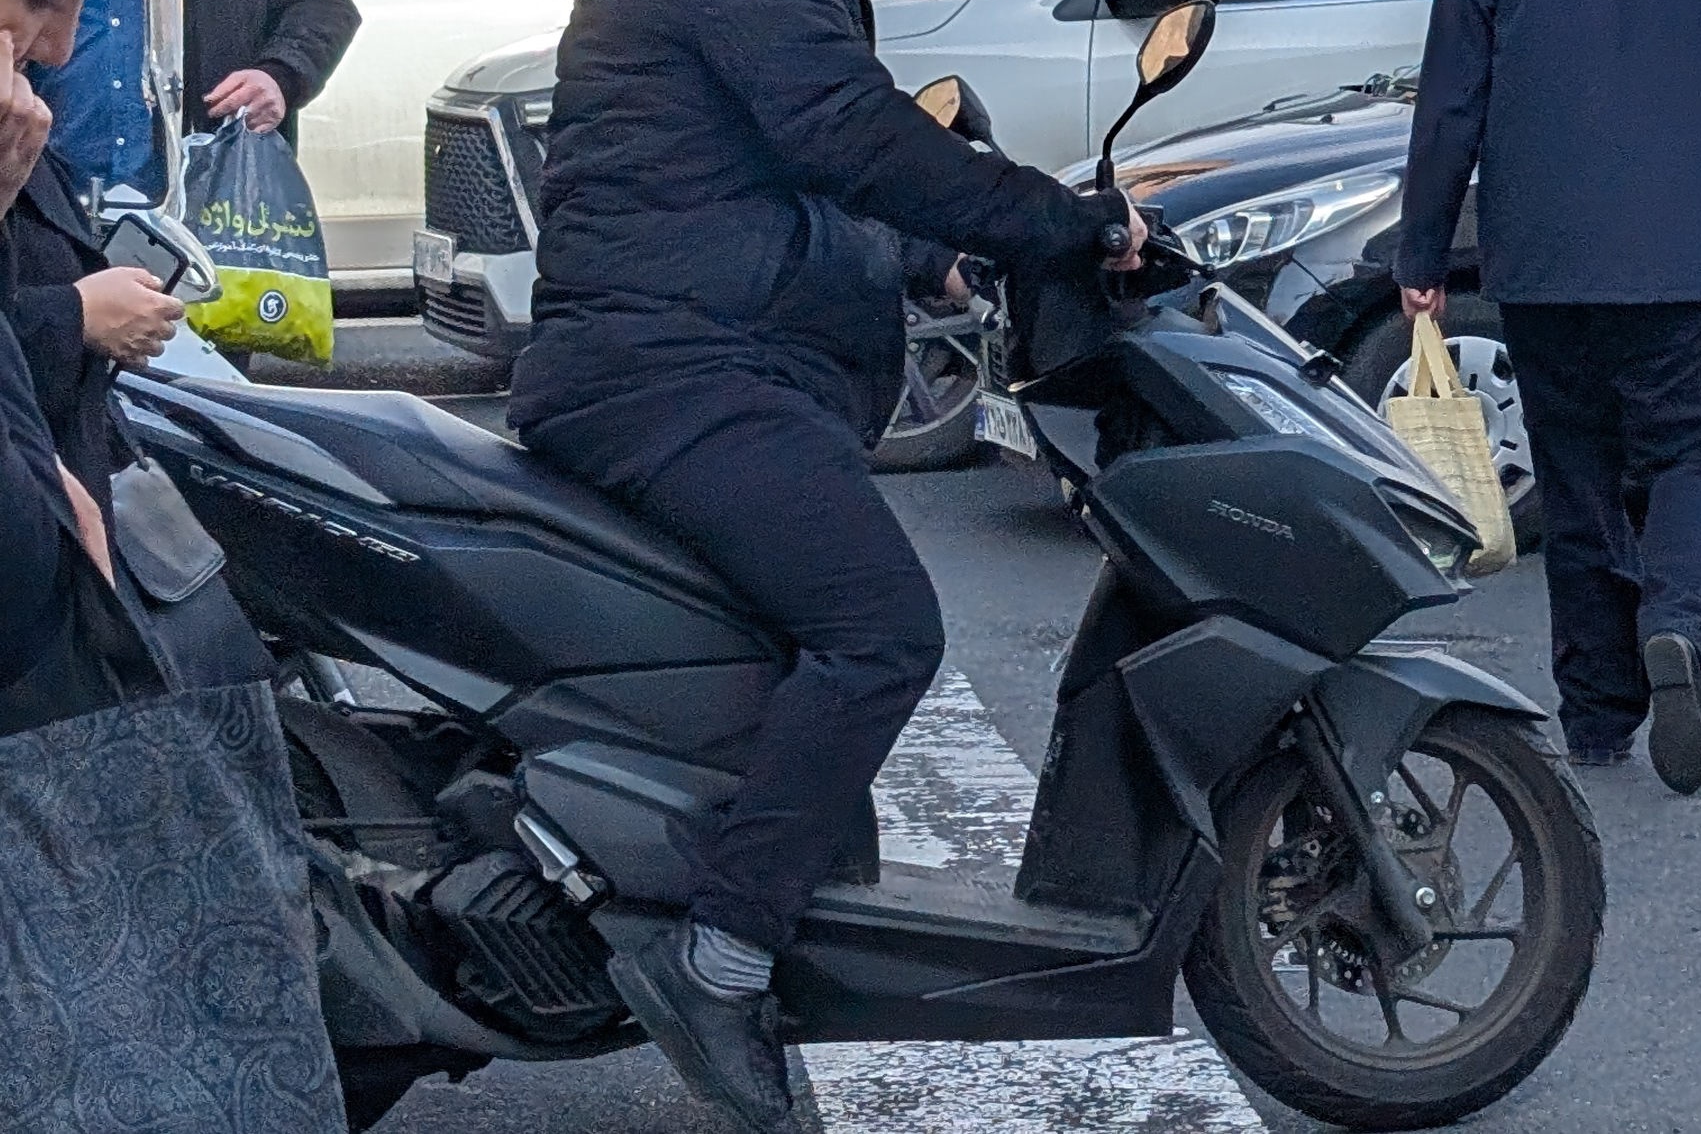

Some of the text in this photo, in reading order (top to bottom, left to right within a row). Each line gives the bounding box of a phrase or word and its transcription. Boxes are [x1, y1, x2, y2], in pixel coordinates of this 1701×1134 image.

[200, 199, 246, 238] واژه
[271, 209, 316, 242] نشر
[1206, 498, 1296, 542] HONDA
